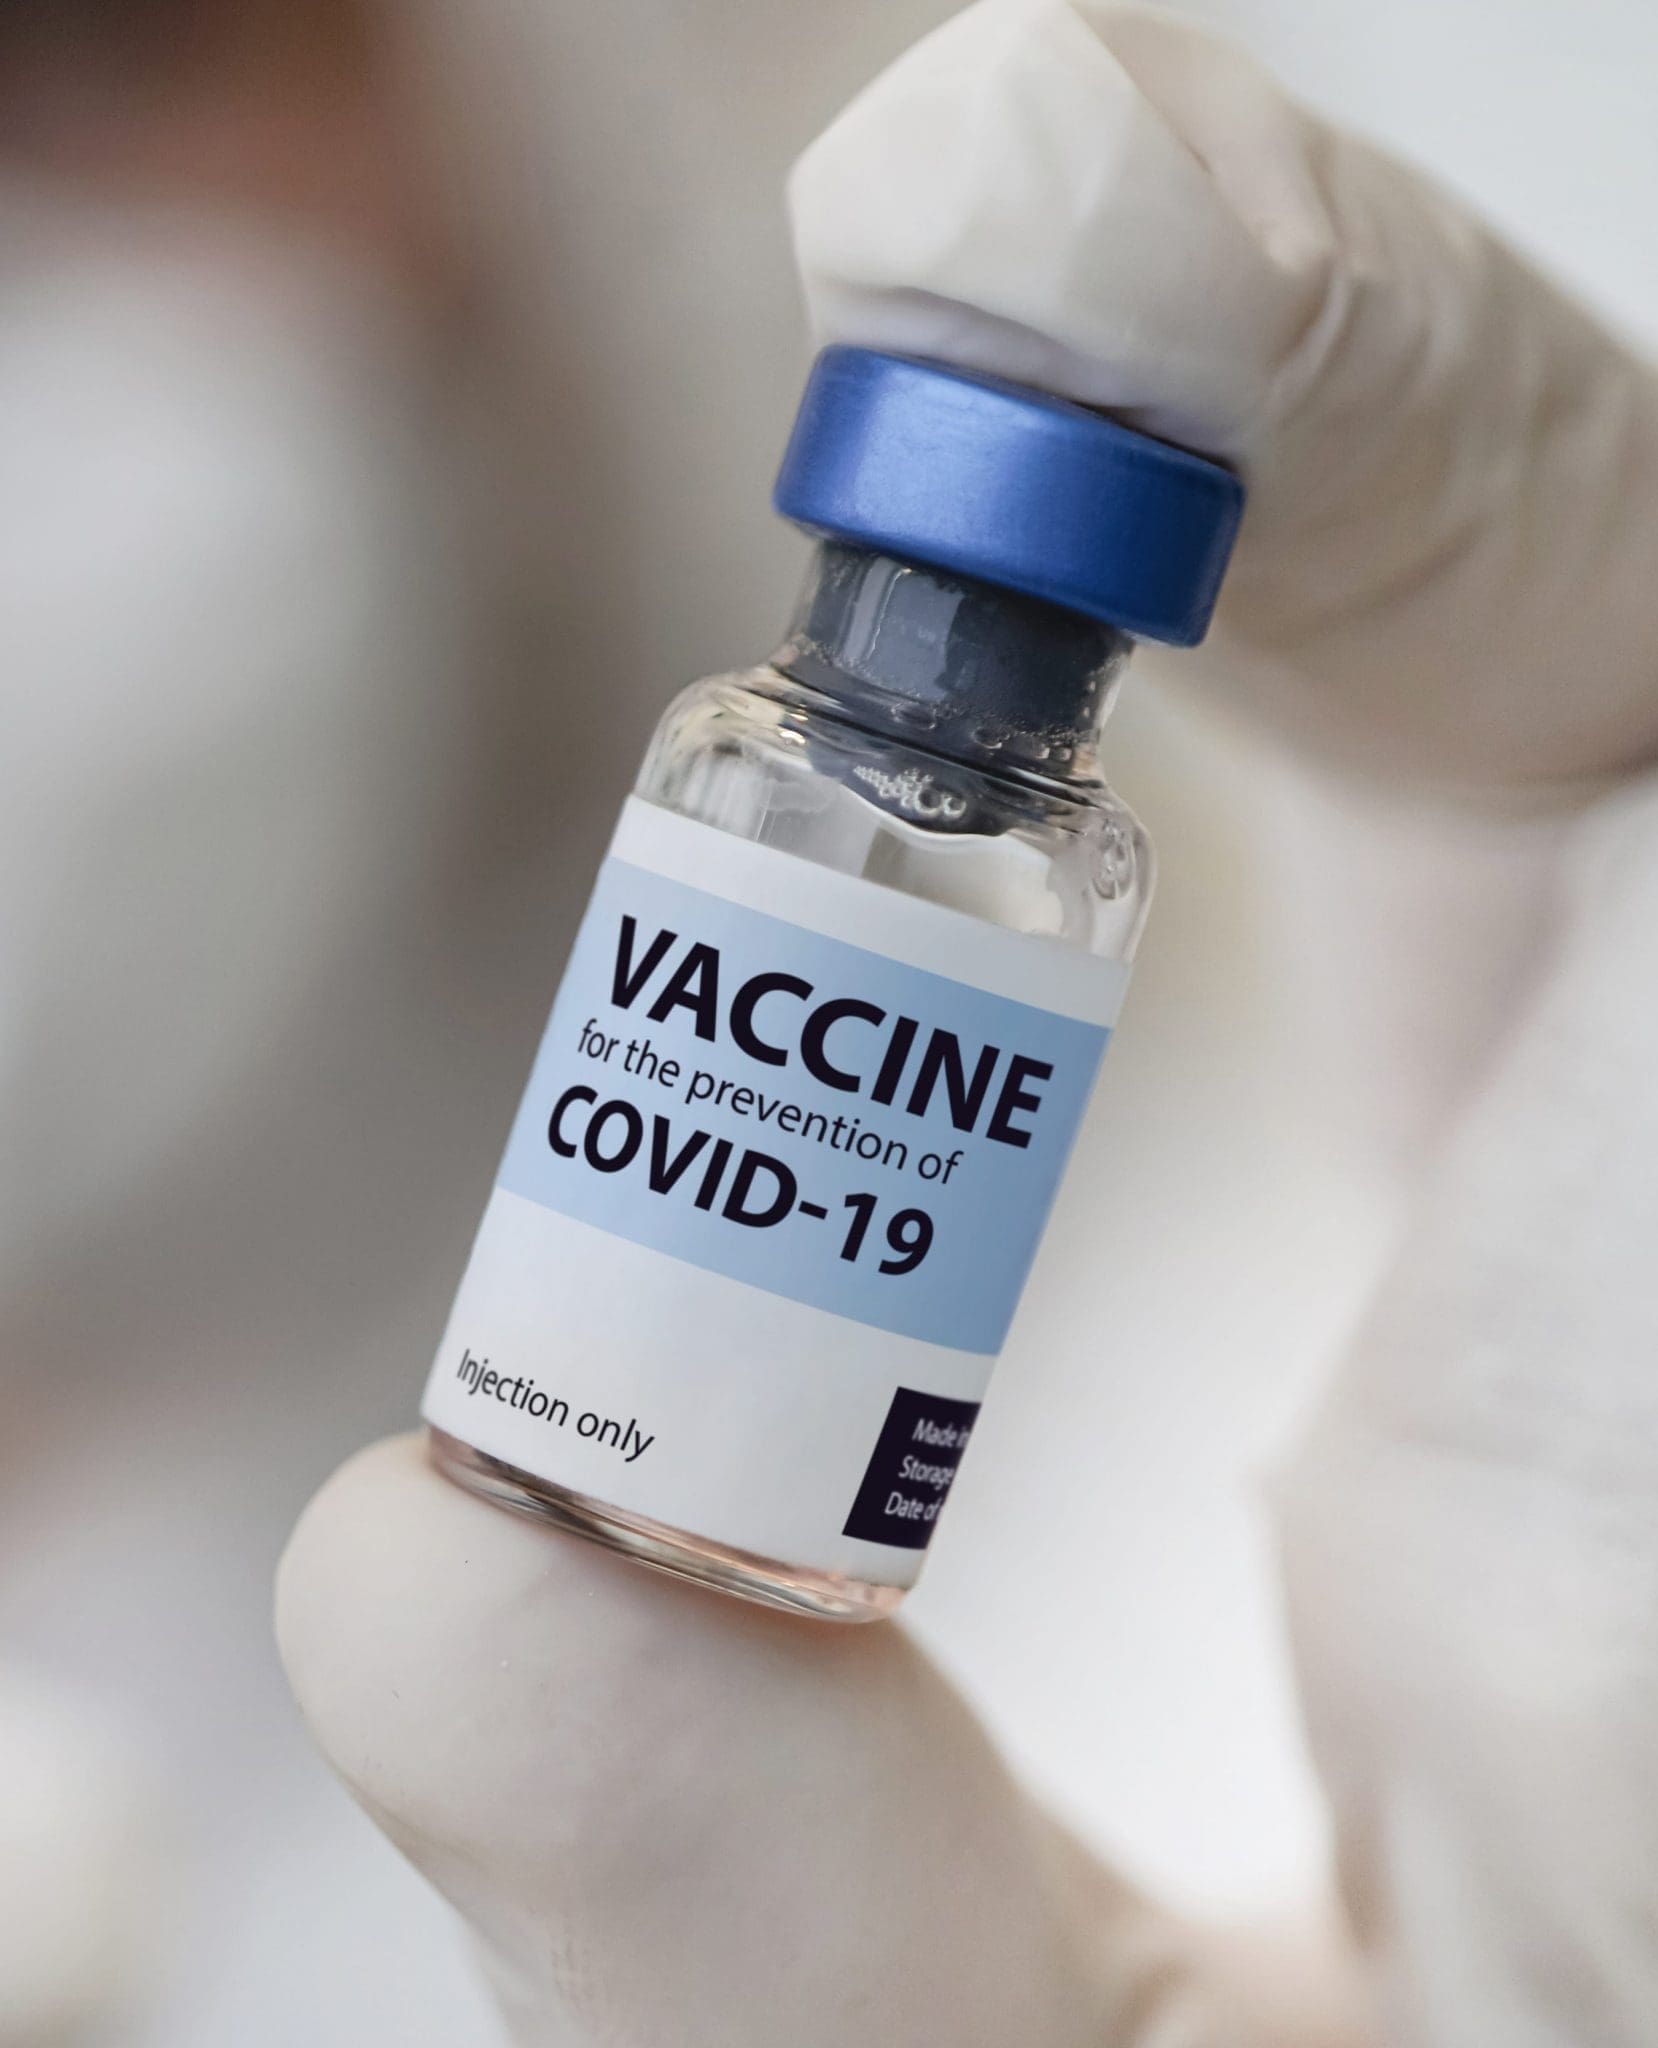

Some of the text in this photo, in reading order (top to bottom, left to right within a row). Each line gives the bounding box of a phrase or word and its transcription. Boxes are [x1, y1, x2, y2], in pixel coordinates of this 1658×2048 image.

[578, 1018, 965, 1185] for the prevention of
[611, 914, 1055, 1150] VACCINE
[548, 1085, 935, 1276] COVID-19
[457, 1349, 655, 1463] Injection only
[911, 1417, 957, 1447] Made
[884, 1490, 923, 1521] Date
